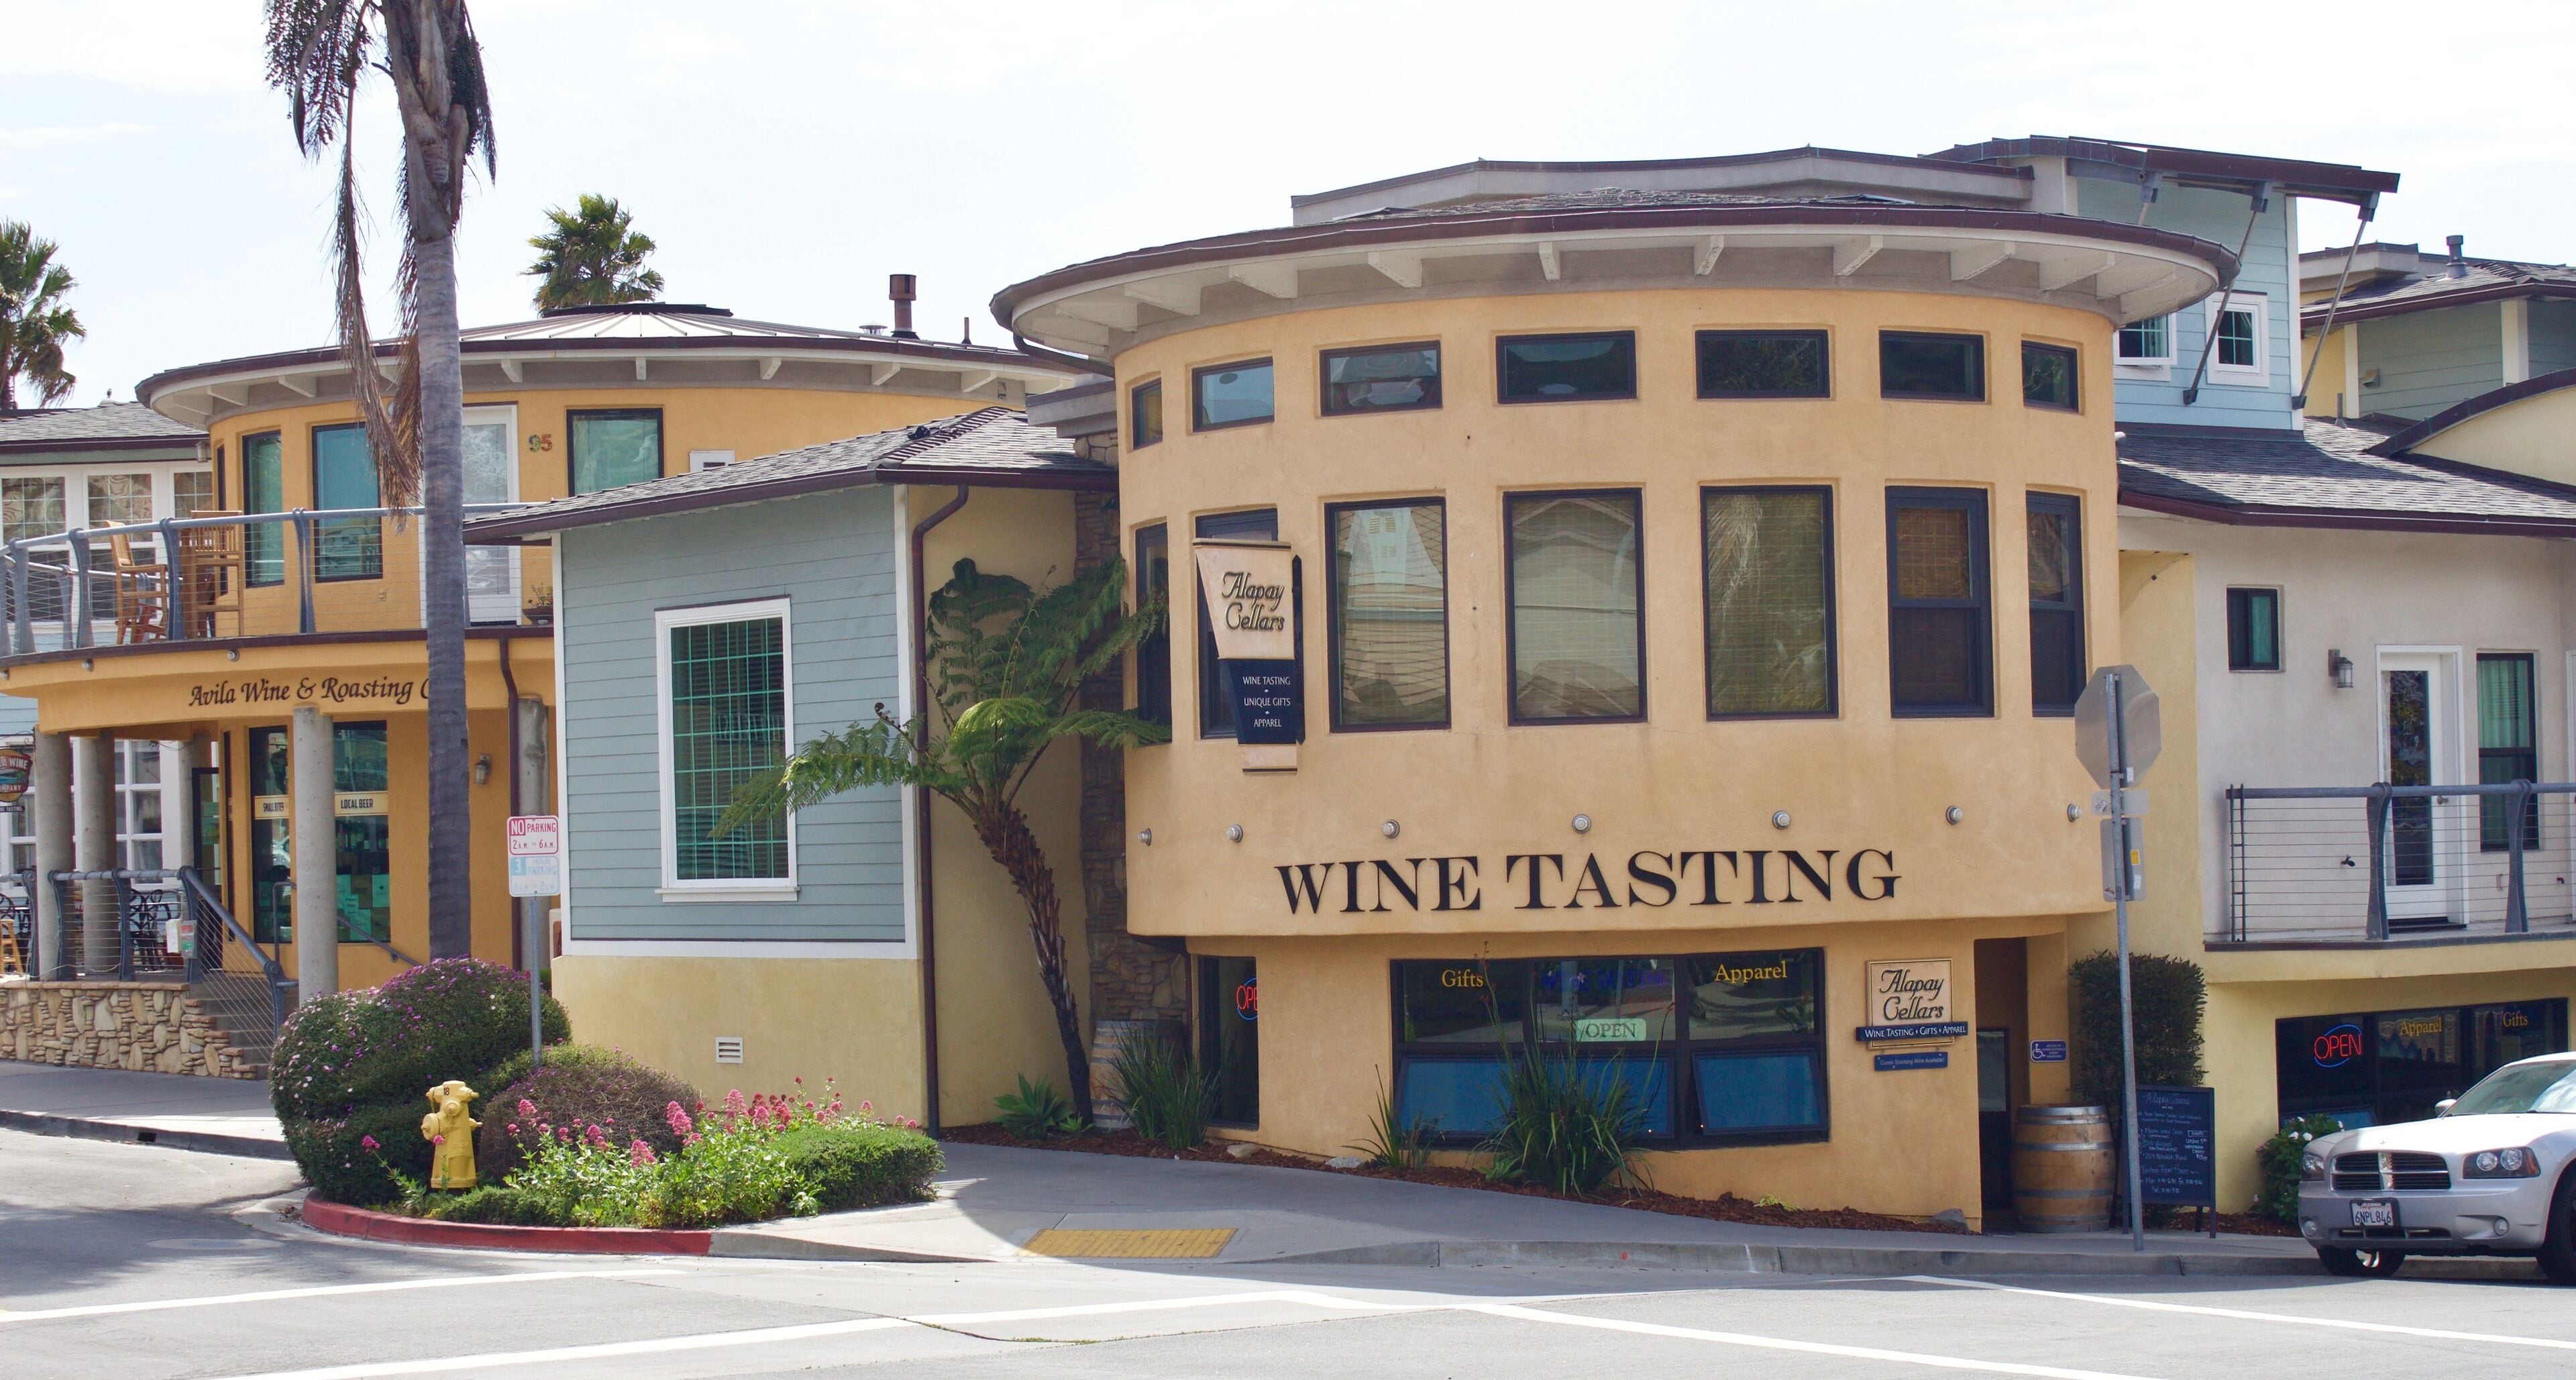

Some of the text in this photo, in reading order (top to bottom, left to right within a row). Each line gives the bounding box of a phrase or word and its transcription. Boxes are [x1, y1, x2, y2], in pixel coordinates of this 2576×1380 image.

[528, 434, 553, 452] 95
[1221, 571, 1285, 611] Alapay
[1225, 602, 1285, 631] Cellars
[1242, 676, 1291, 685] WINE TASTING
[189, 680, 236, 706] Avila
[241, 678, 290, 702] Wine
[297, 678, 316, 699] &
[321, 676, 414, 704] Roasting
[1244, 697, 1291, 706] UNIQUE GIFTS
[1254, 719, 1282, 727] APPAREL
[9, 757, 28, 769] WINE
[263, 802, 274, 812] SMALL
[341, 798, 373, 808] LOCAL BEER
[511, 820, 555, 835] NO PARKING
[515, 859, 521, 873] 3
[528, 866, 556, 875] PARKING
[1275, 849, 1901, 913] WINE TASTING
[1442, 969, 1483, 988] Gifts
[1715, 960, 1788, 984] Apparel
[1880, 969, 1944, 1001] Alapay
[1236, 986, 1258, 1010] OPE
[1883, 996, 1943, 1021] Cellars
[2400, 1016, 2443, 1036] Apparel
[2503, 1011, 2528, 1027] Gifts
[1585, 1023, 1636, 1038] OPEN
[1865, 1026, 1966, 1038] WINE TASTING GIFTS APPAREL
[2314, 1033, 2362, 1059] OPEN
[443, 1087, 449, 1096] 18
[2355, 1211, 2392, 1223] 6NPL846
